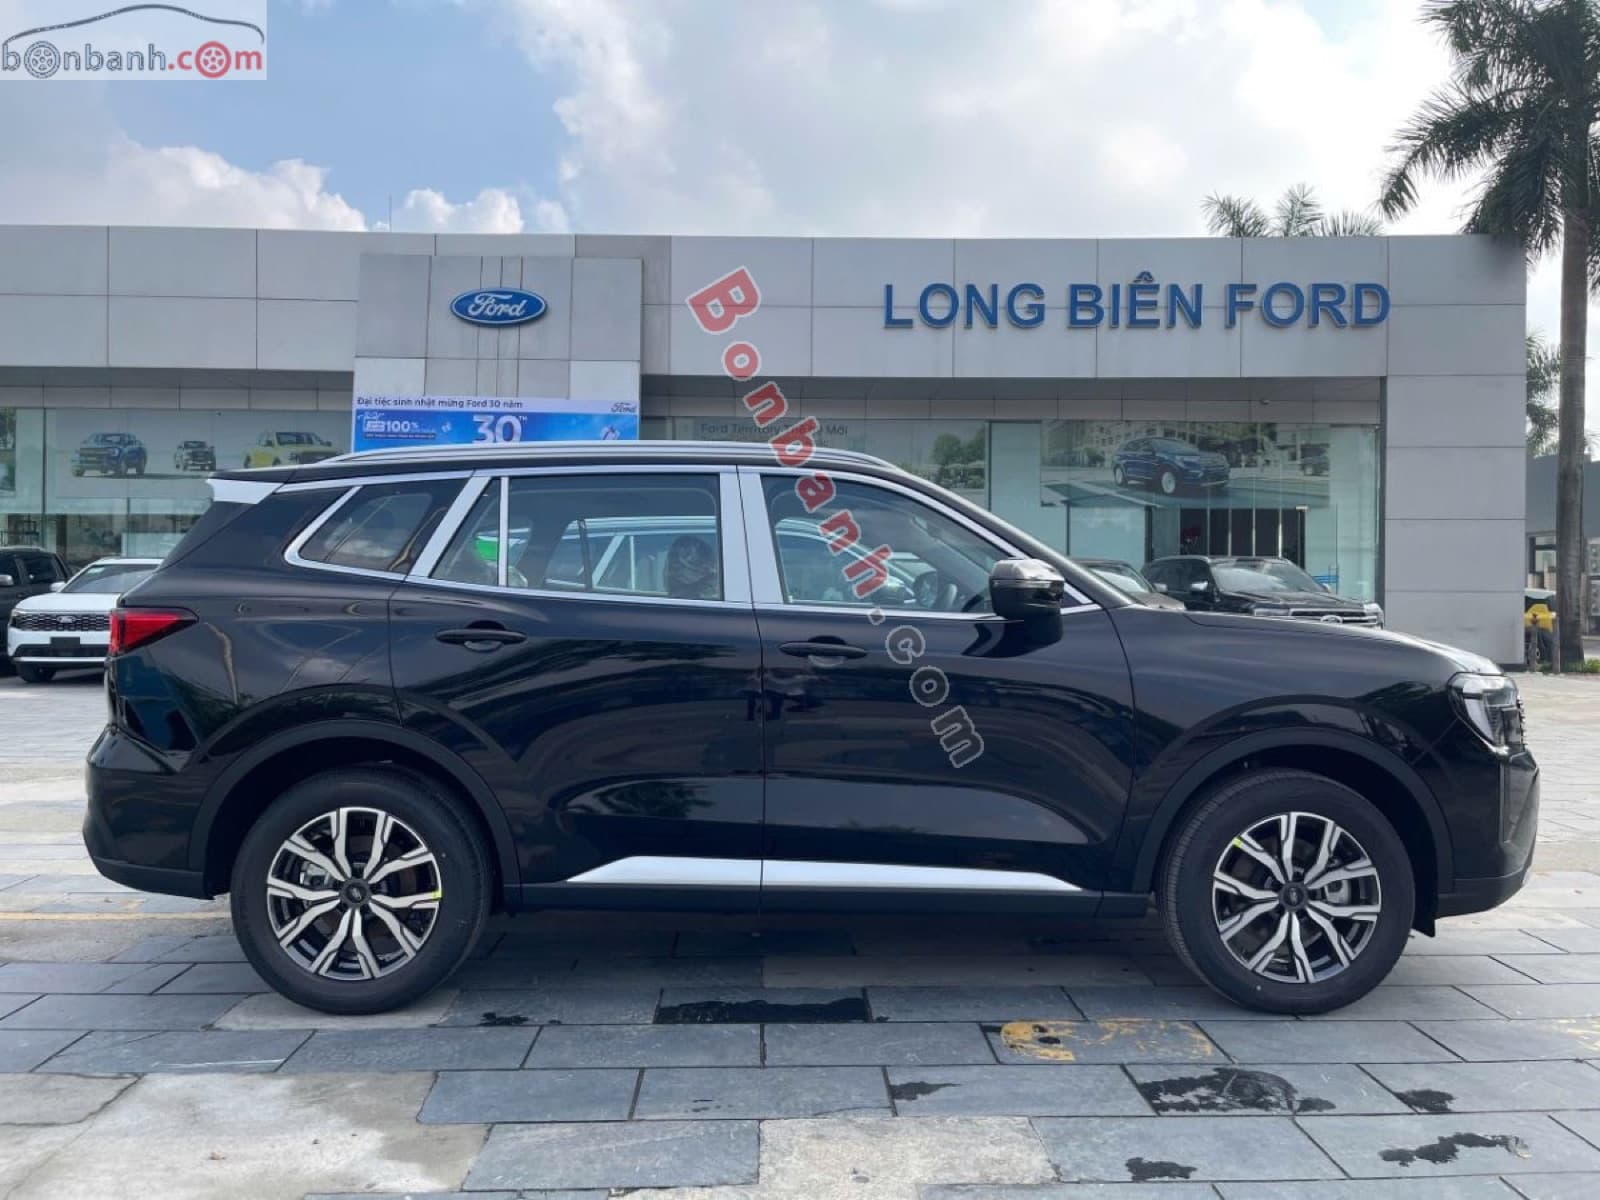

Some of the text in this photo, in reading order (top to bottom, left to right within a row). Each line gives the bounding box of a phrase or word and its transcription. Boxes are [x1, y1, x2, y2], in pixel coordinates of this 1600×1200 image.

[468, 292, 528, 317] Ford
[884, 271, 1391, 329] LONG BIÊN FORD
[393, 398, 413, 406] sinh
[466, 399, 488, 408] Ford
[489, 399, 501, 408] 30
[503, 401, 523, 409] năm
[701, 423, 729, 434] Ford
